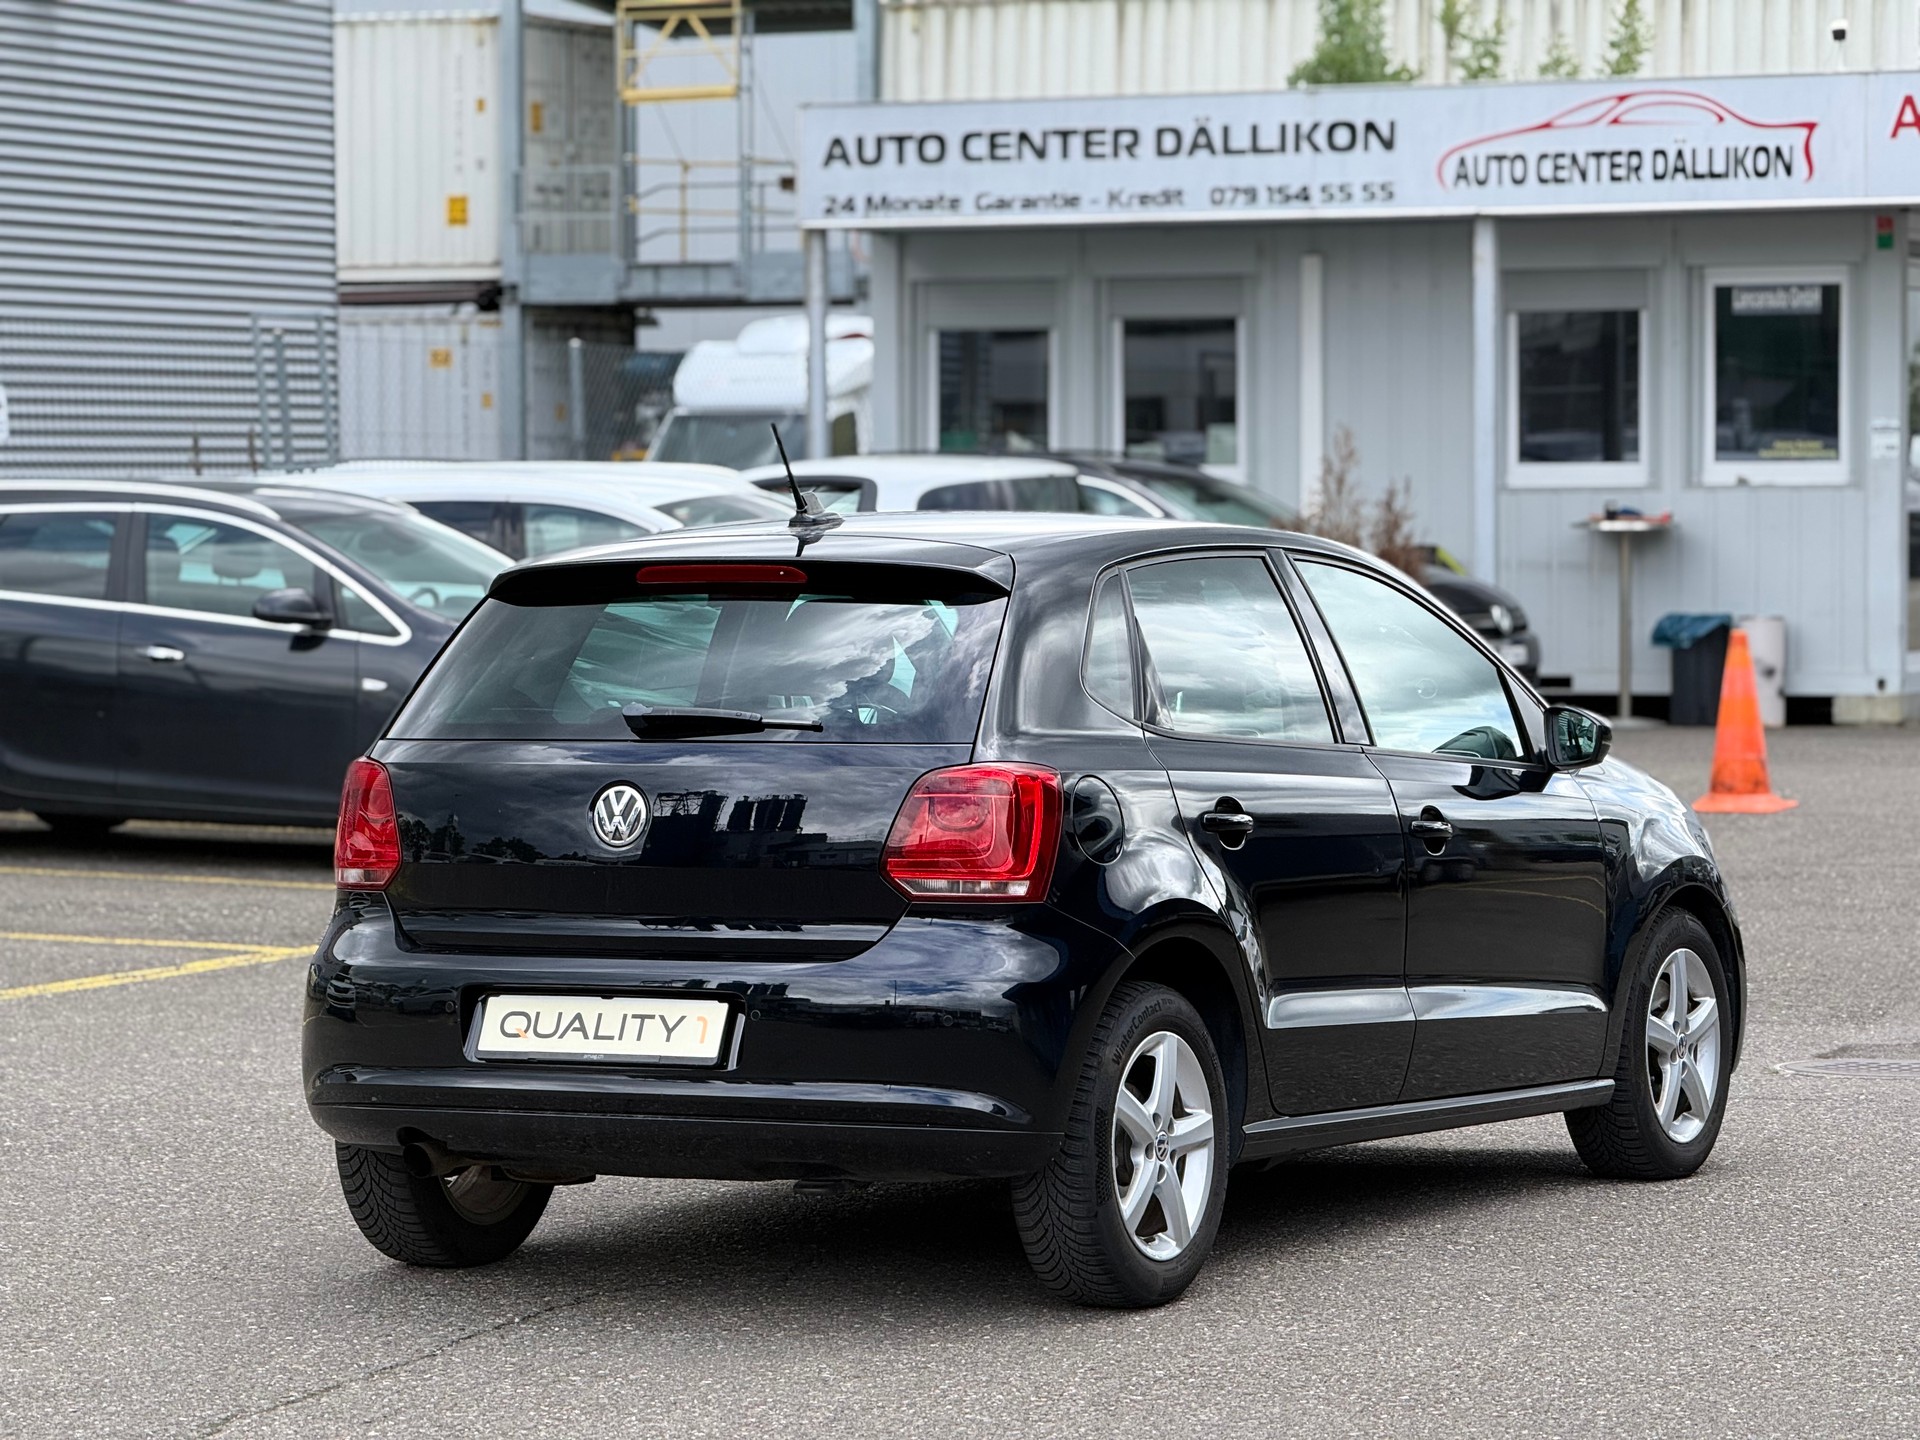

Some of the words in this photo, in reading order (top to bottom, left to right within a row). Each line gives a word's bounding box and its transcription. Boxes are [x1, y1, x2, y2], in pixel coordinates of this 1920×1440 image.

[823, 133, 947, 168] AUTO
[961, 128, 1139, 162] CENTER
[1156, 116, 1395, 158] DÄLLIKON
[1454, 153, 1528, 187] AUTO
[1537, 149, 1643, 184] CENTER
[1653, 137, 1794, 181] DÄLLIKON
[824, 195, 856, 216] 24
[864, 193, 962, 215] Monate
[974, 191, 1081, 212] Garantie
[1107, 188, 1184, 209] Kredit
[1209, 185, 1258, 206] 079
[1266, 183, 1311, 205] 154
[1319, 181, 1354, 203] 55
[1361, 180, 1395, 202] 55
[593, 784, 647, 847] VW
[499, 1010, 688, 1043] QUALITY
[696, 1015, 709, 1044] 1
[1111, 999, 1163, 1066] WinterContact
